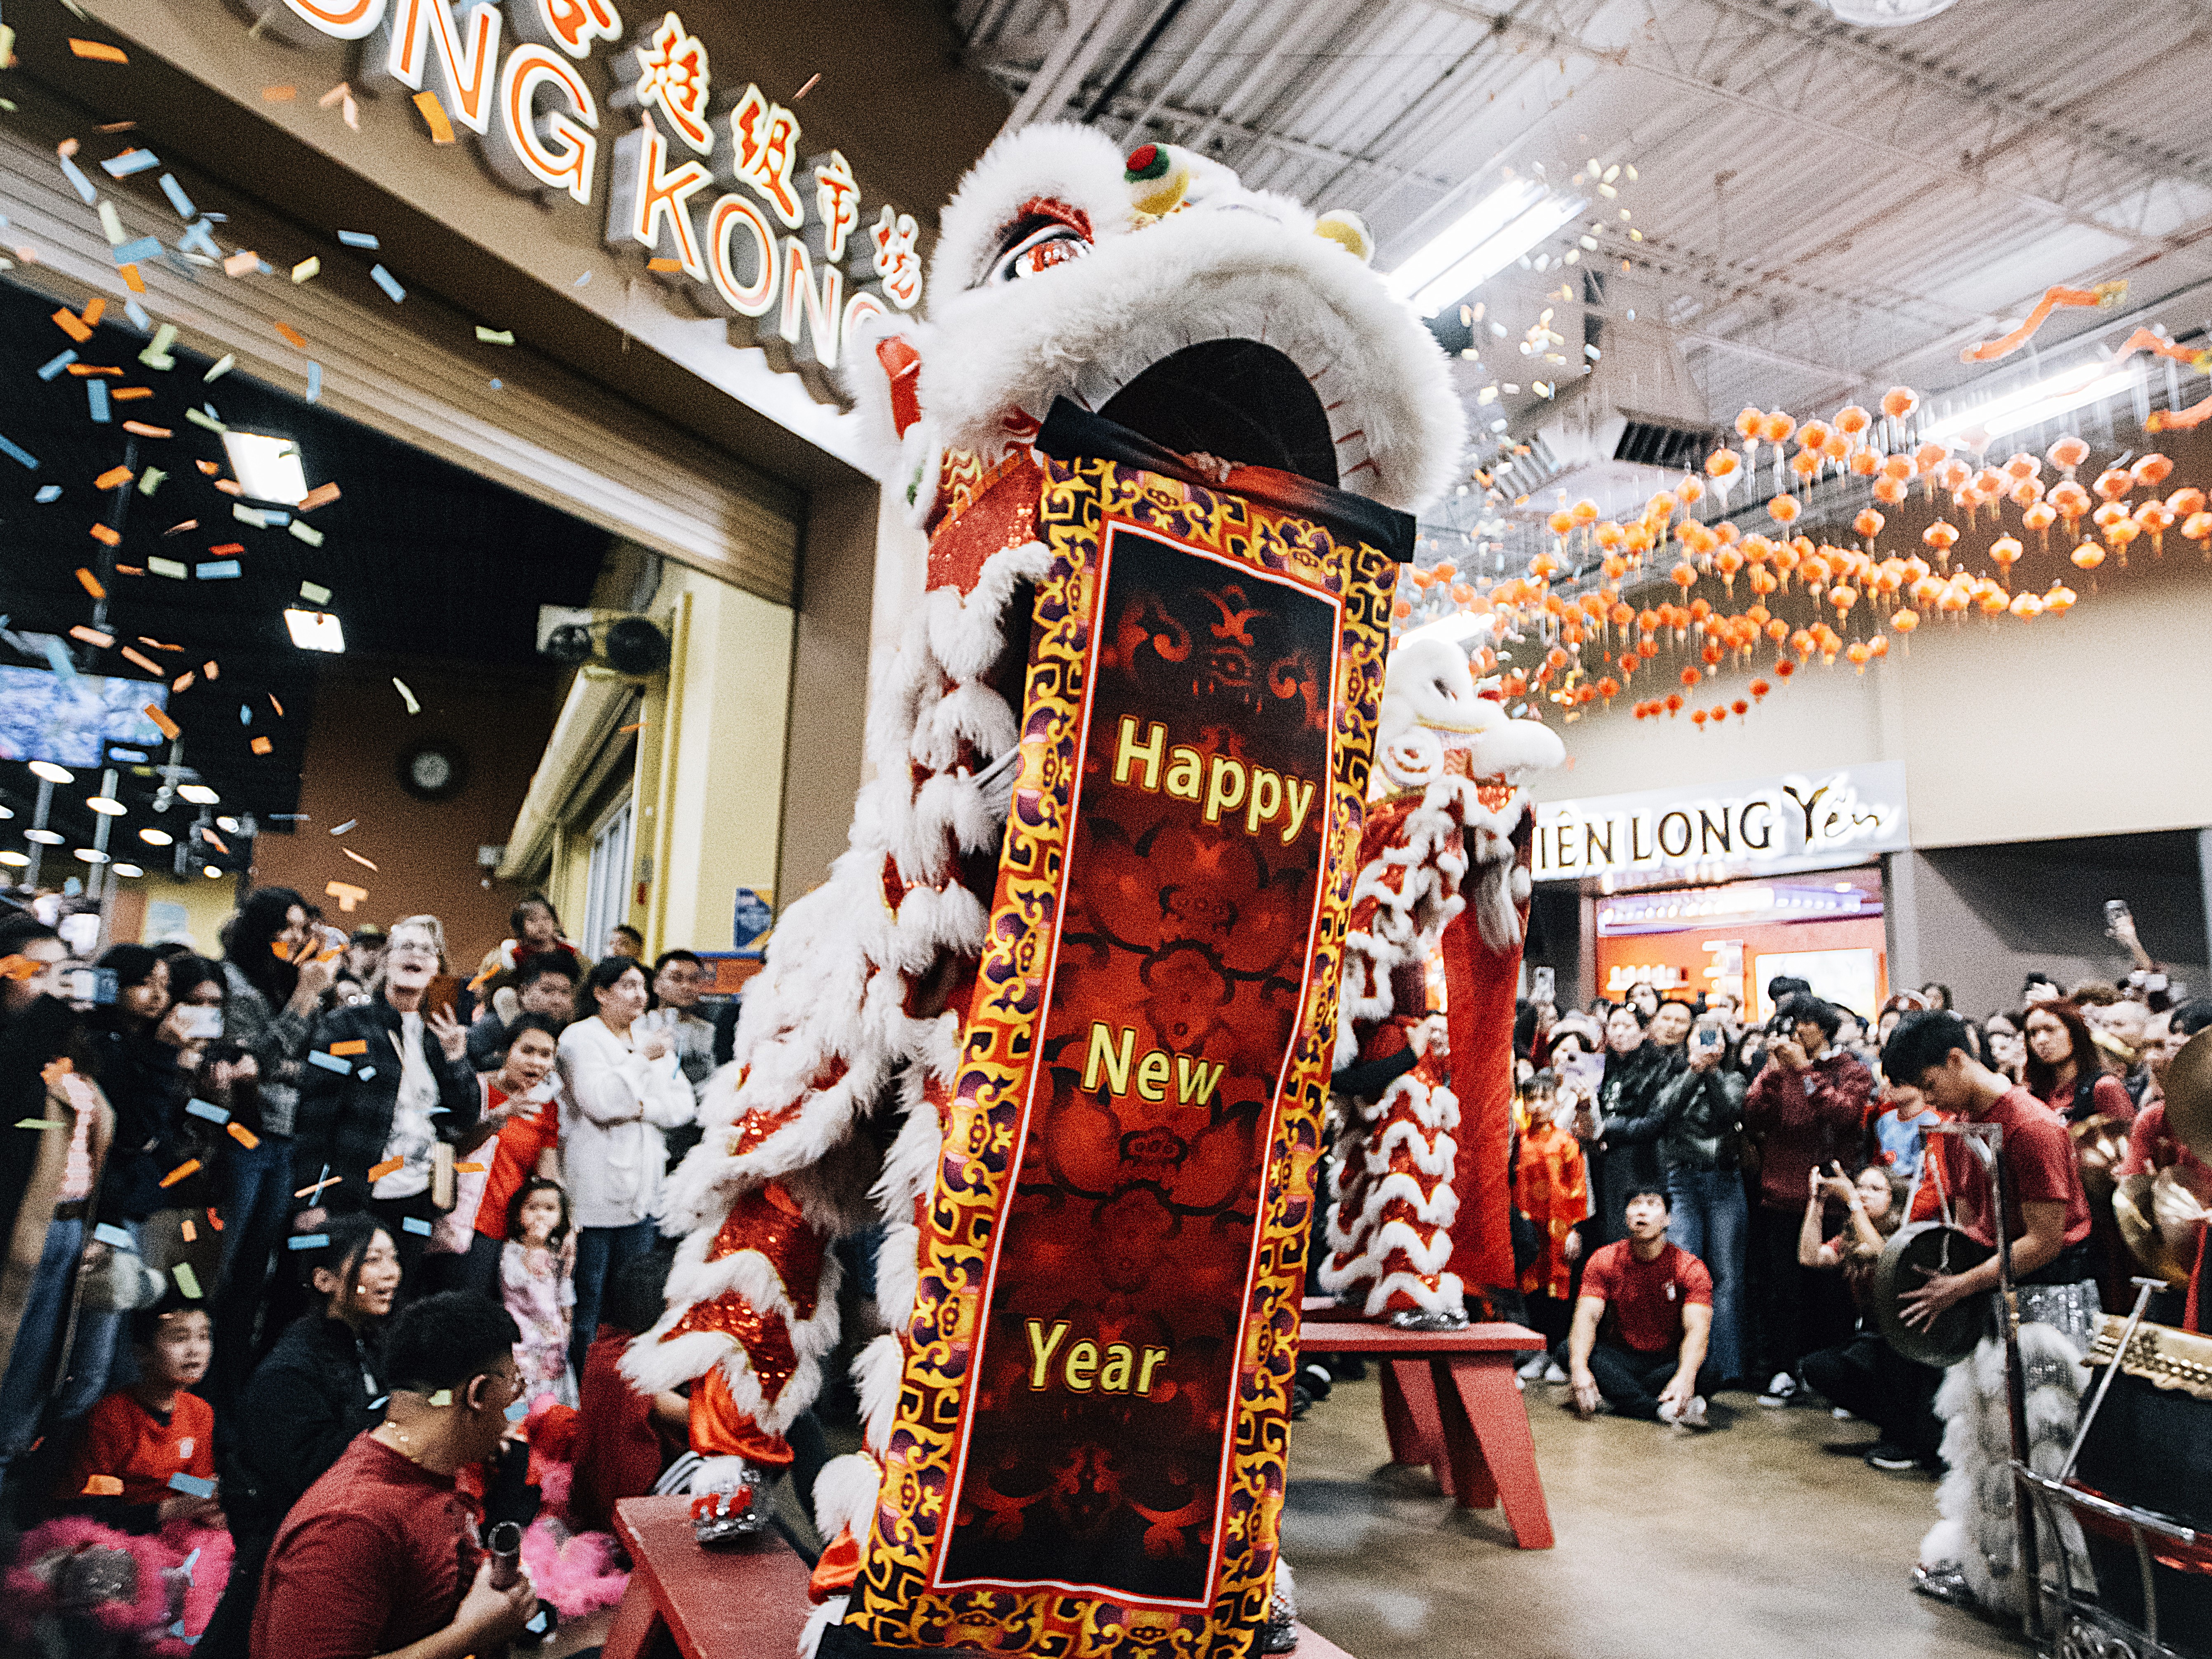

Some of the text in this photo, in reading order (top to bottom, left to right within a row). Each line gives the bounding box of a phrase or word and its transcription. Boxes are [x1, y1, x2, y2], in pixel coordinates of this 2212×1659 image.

[1114, 716, 1315, 844] Happy
[1631, 801, 1773, 861] LONG
[1082, 1021, 1224, 1106] New
[1026, 1319, 1168, 1397] Year
